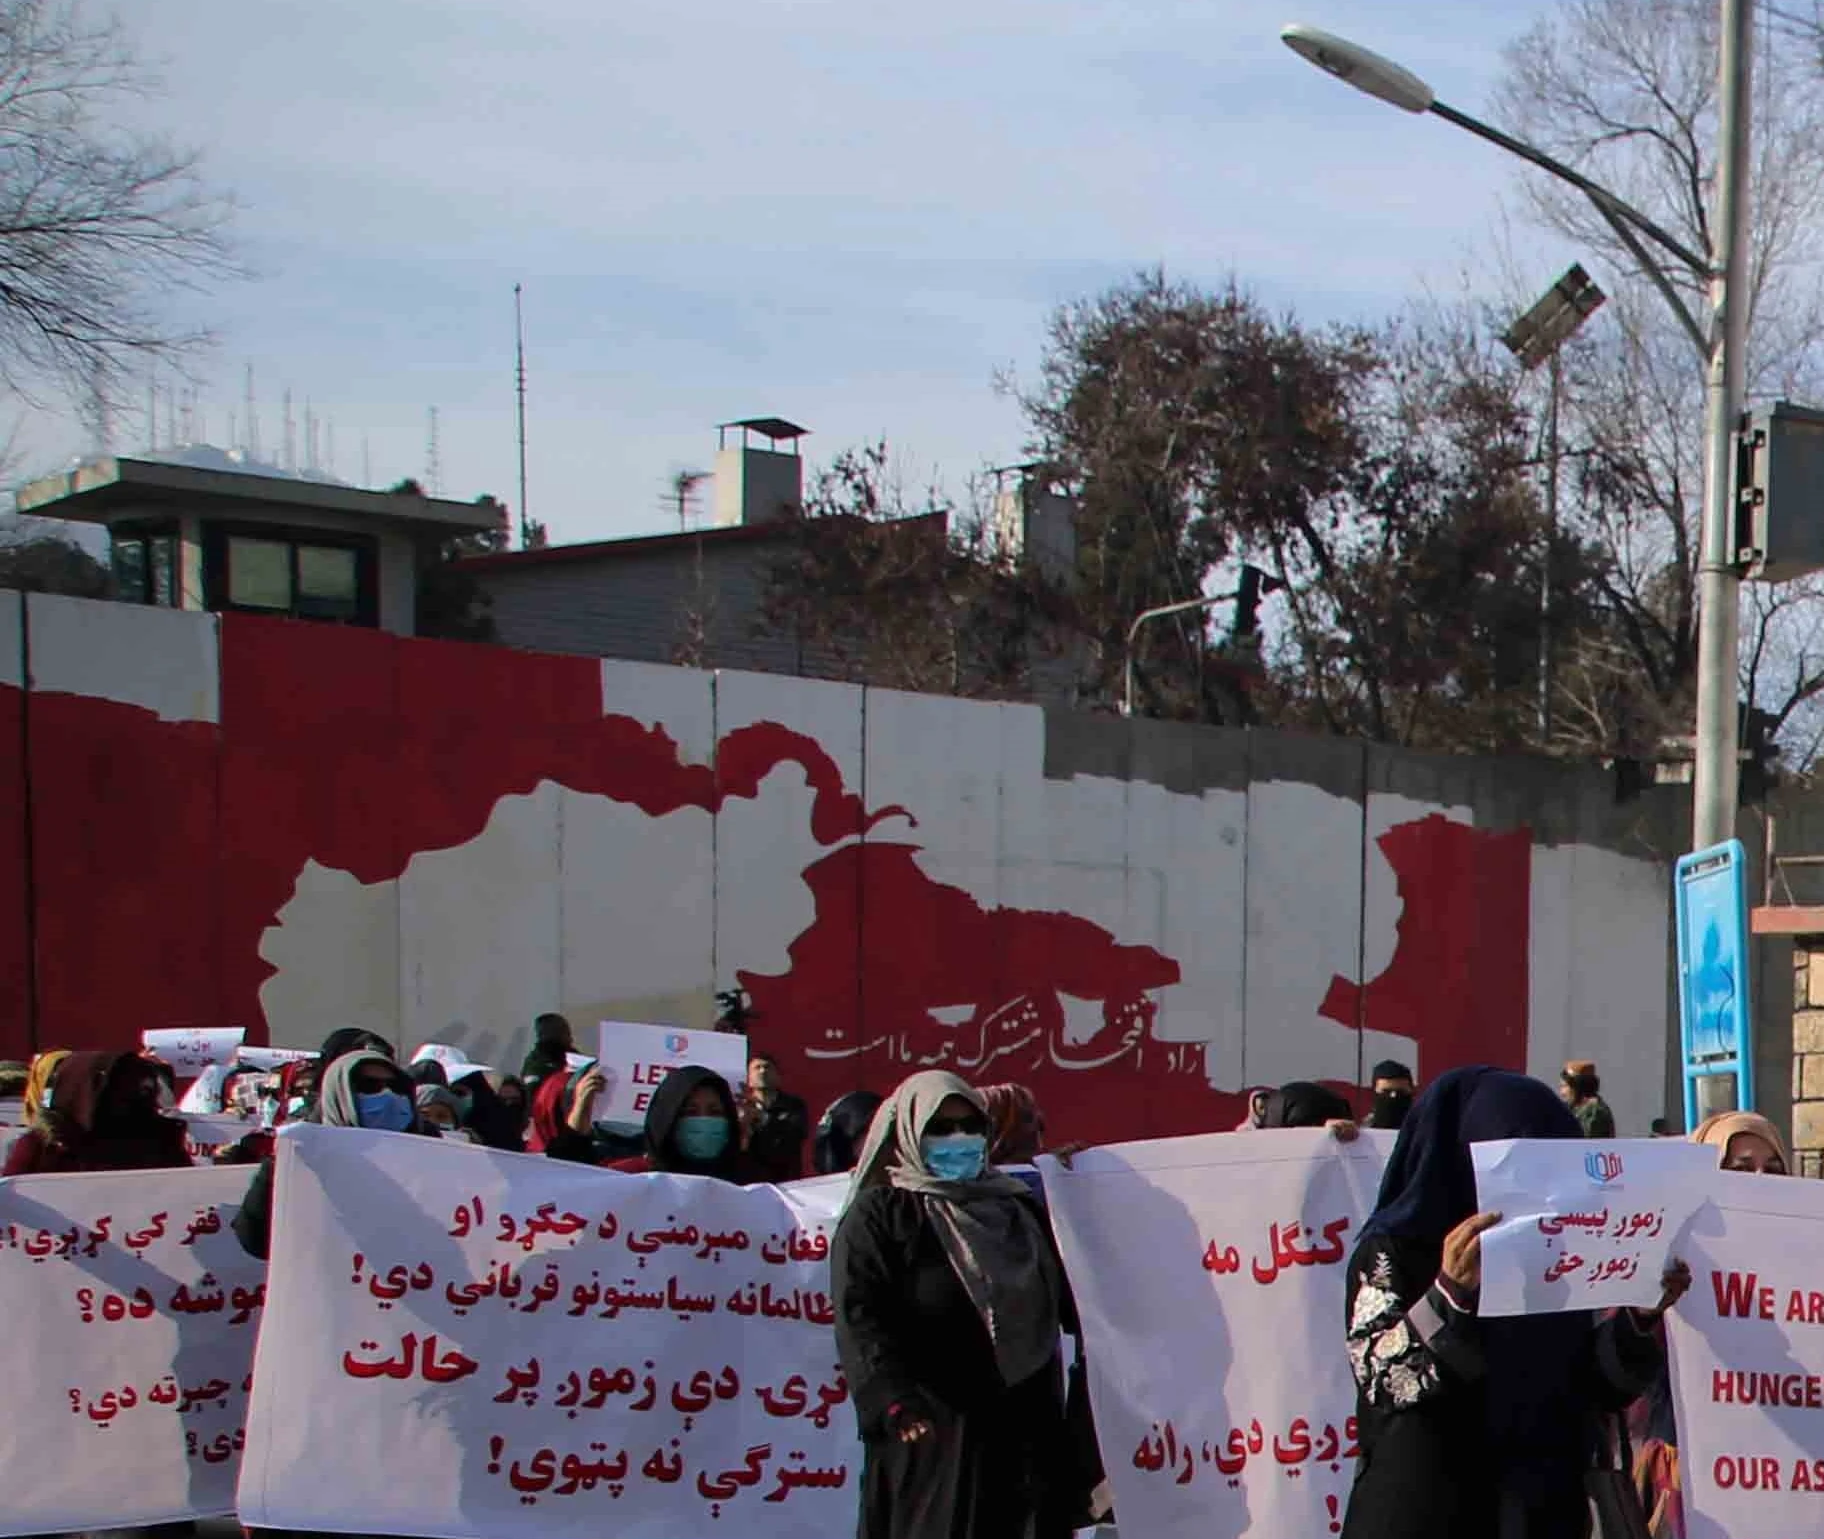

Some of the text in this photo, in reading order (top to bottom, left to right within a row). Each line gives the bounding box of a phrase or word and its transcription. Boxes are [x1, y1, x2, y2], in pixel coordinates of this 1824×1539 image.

[1166, 1042, 1203, 1074] زاد
[448, 1195, 483, 1238] او
[598, 1212, 618, 1239] د
[761, 1225, 829, 1264] فغان
[1201, 1240, 1240, 1274] مه
[1544, 1251, 1584, 1282] حق
[343, 1331, 478, 1383] حالت
[493, 1357, 541, 1406] پر
[554, 1360, 656, 1419] زموږ
[641, 1438, 683, 1483] نه
[1713, 1456, 1779, 1491] OUR
